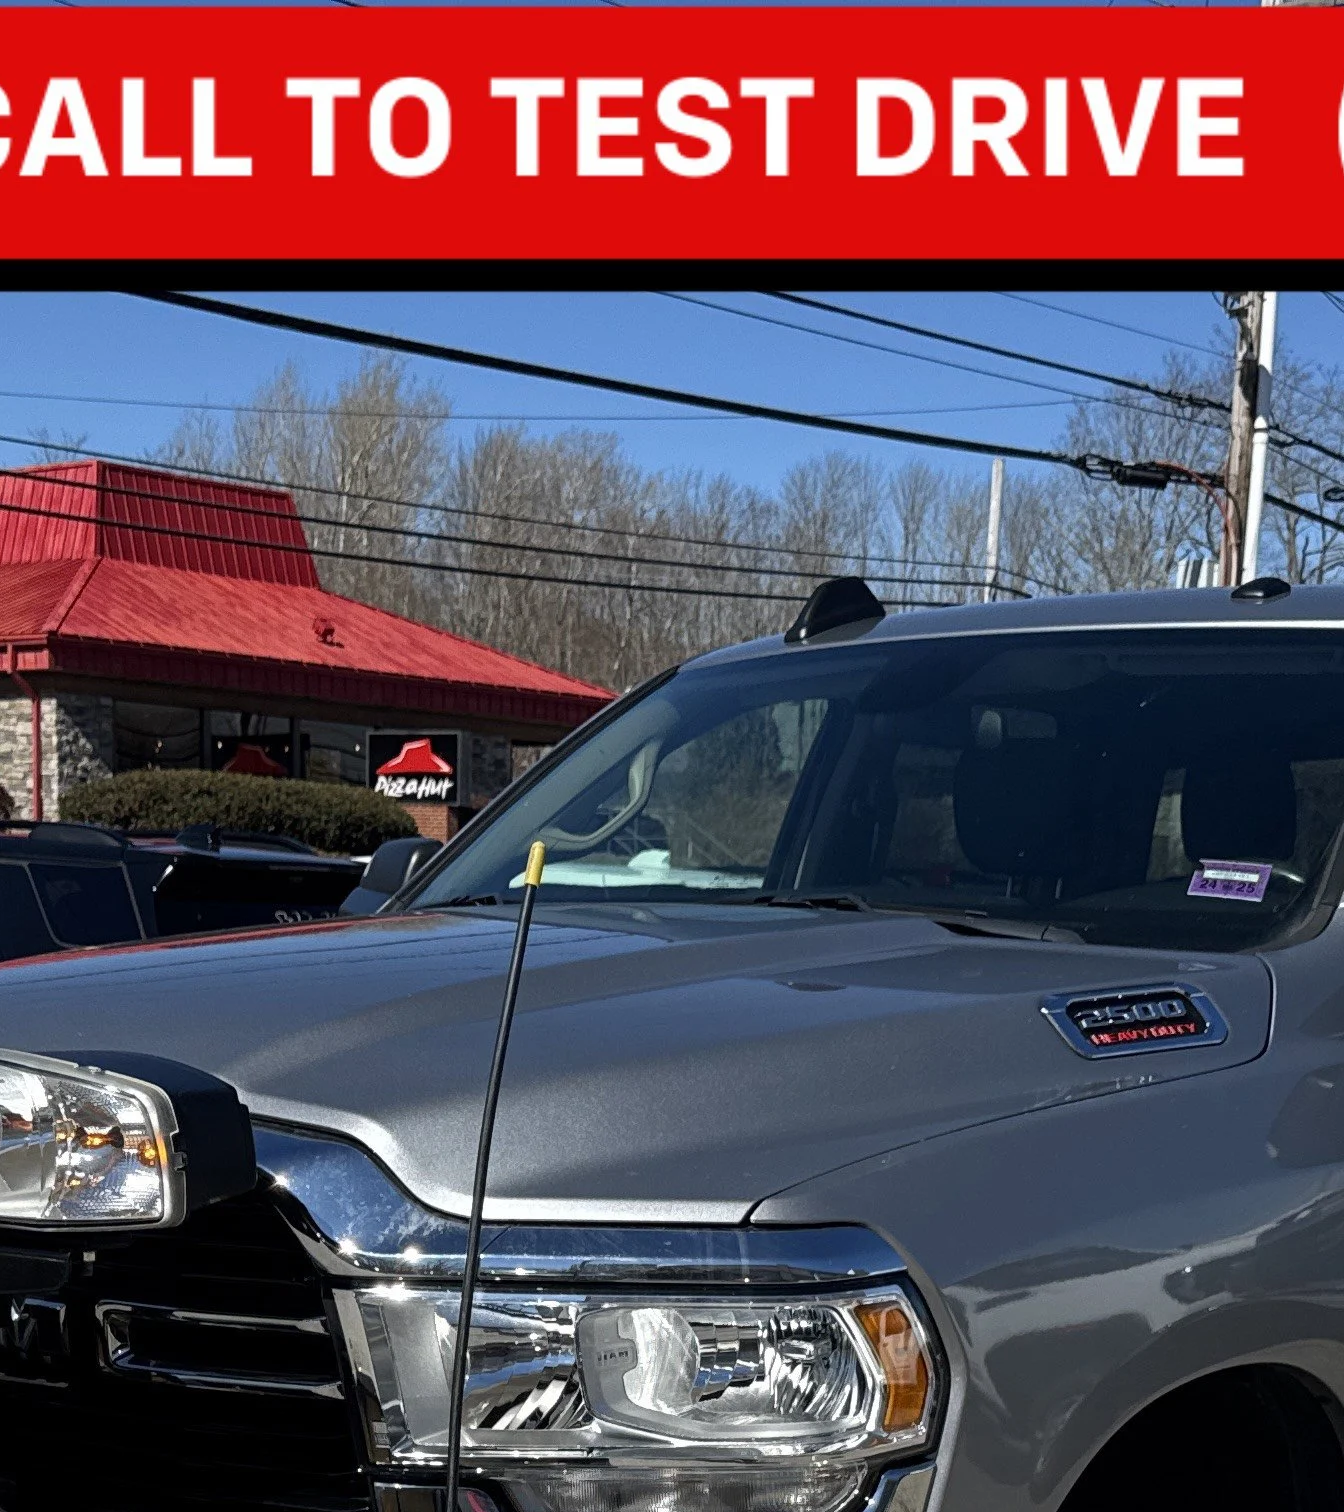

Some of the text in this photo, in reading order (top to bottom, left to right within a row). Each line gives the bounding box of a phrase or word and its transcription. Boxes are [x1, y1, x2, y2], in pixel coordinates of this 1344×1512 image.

[1236, 881, 1256, 894] 25
[1074, 1000, 1187, 1029] 2500
[1090, 1022, 1196, 1046] HEAVY DUTY
